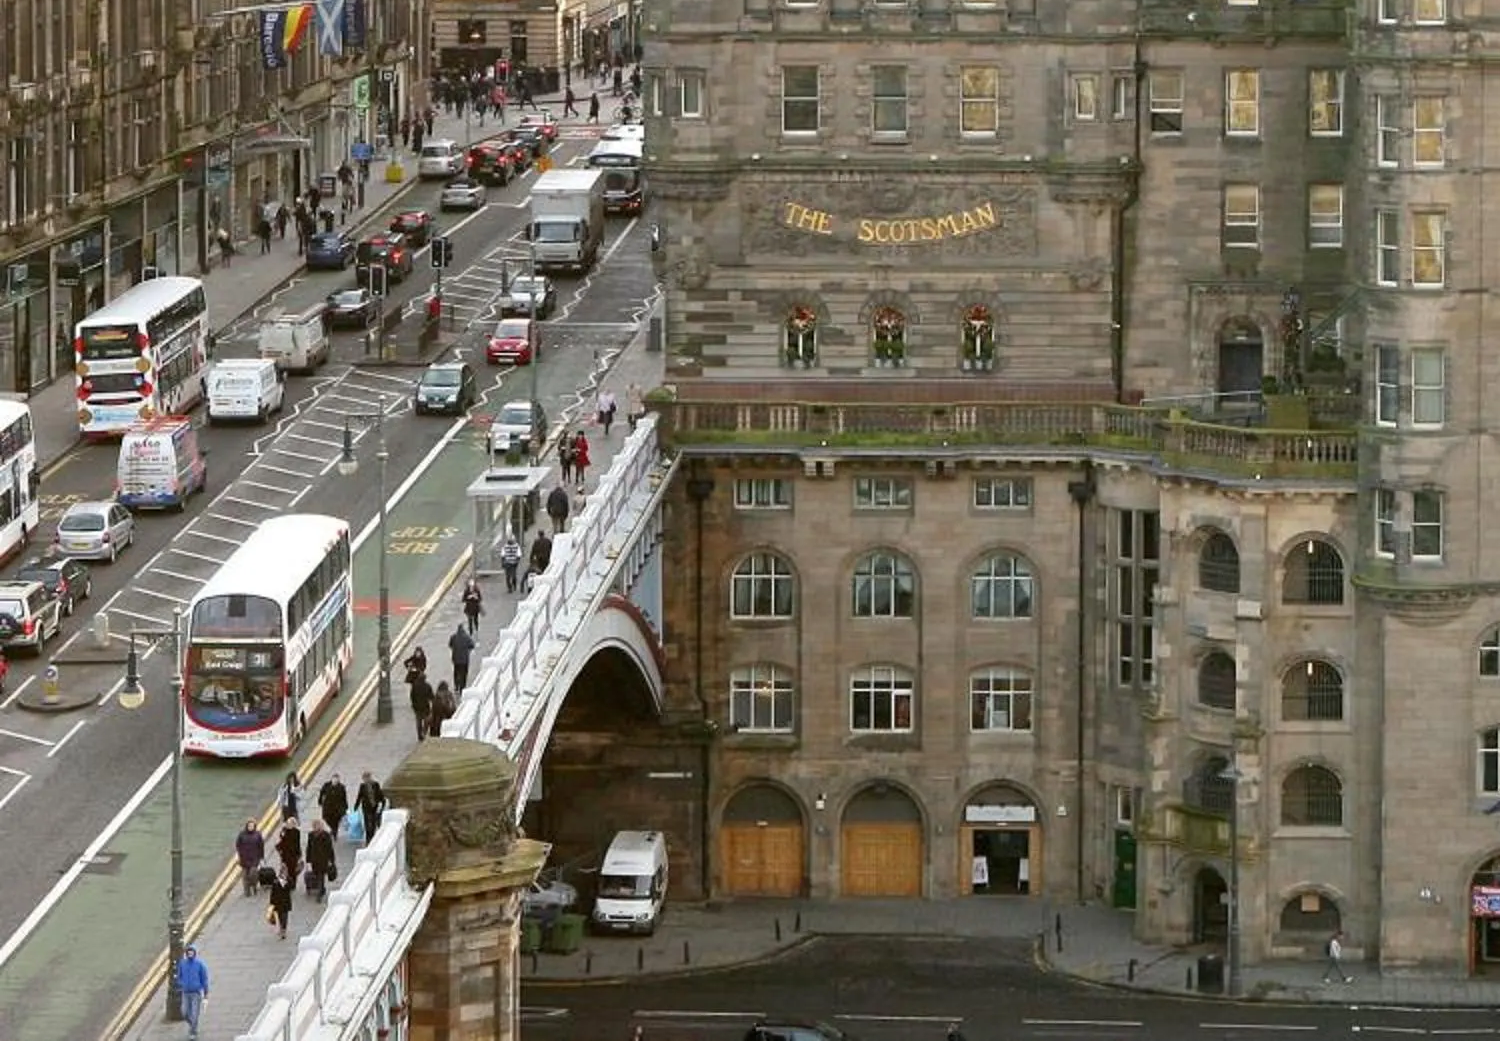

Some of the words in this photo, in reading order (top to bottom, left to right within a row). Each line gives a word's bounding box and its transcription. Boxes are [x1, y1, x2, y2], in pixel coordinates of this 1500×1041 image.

[785, 202, 833, 236] THE
[857, 201, 997, 243] SCOTSMAN
[385, 542, 440, 554] BUS
